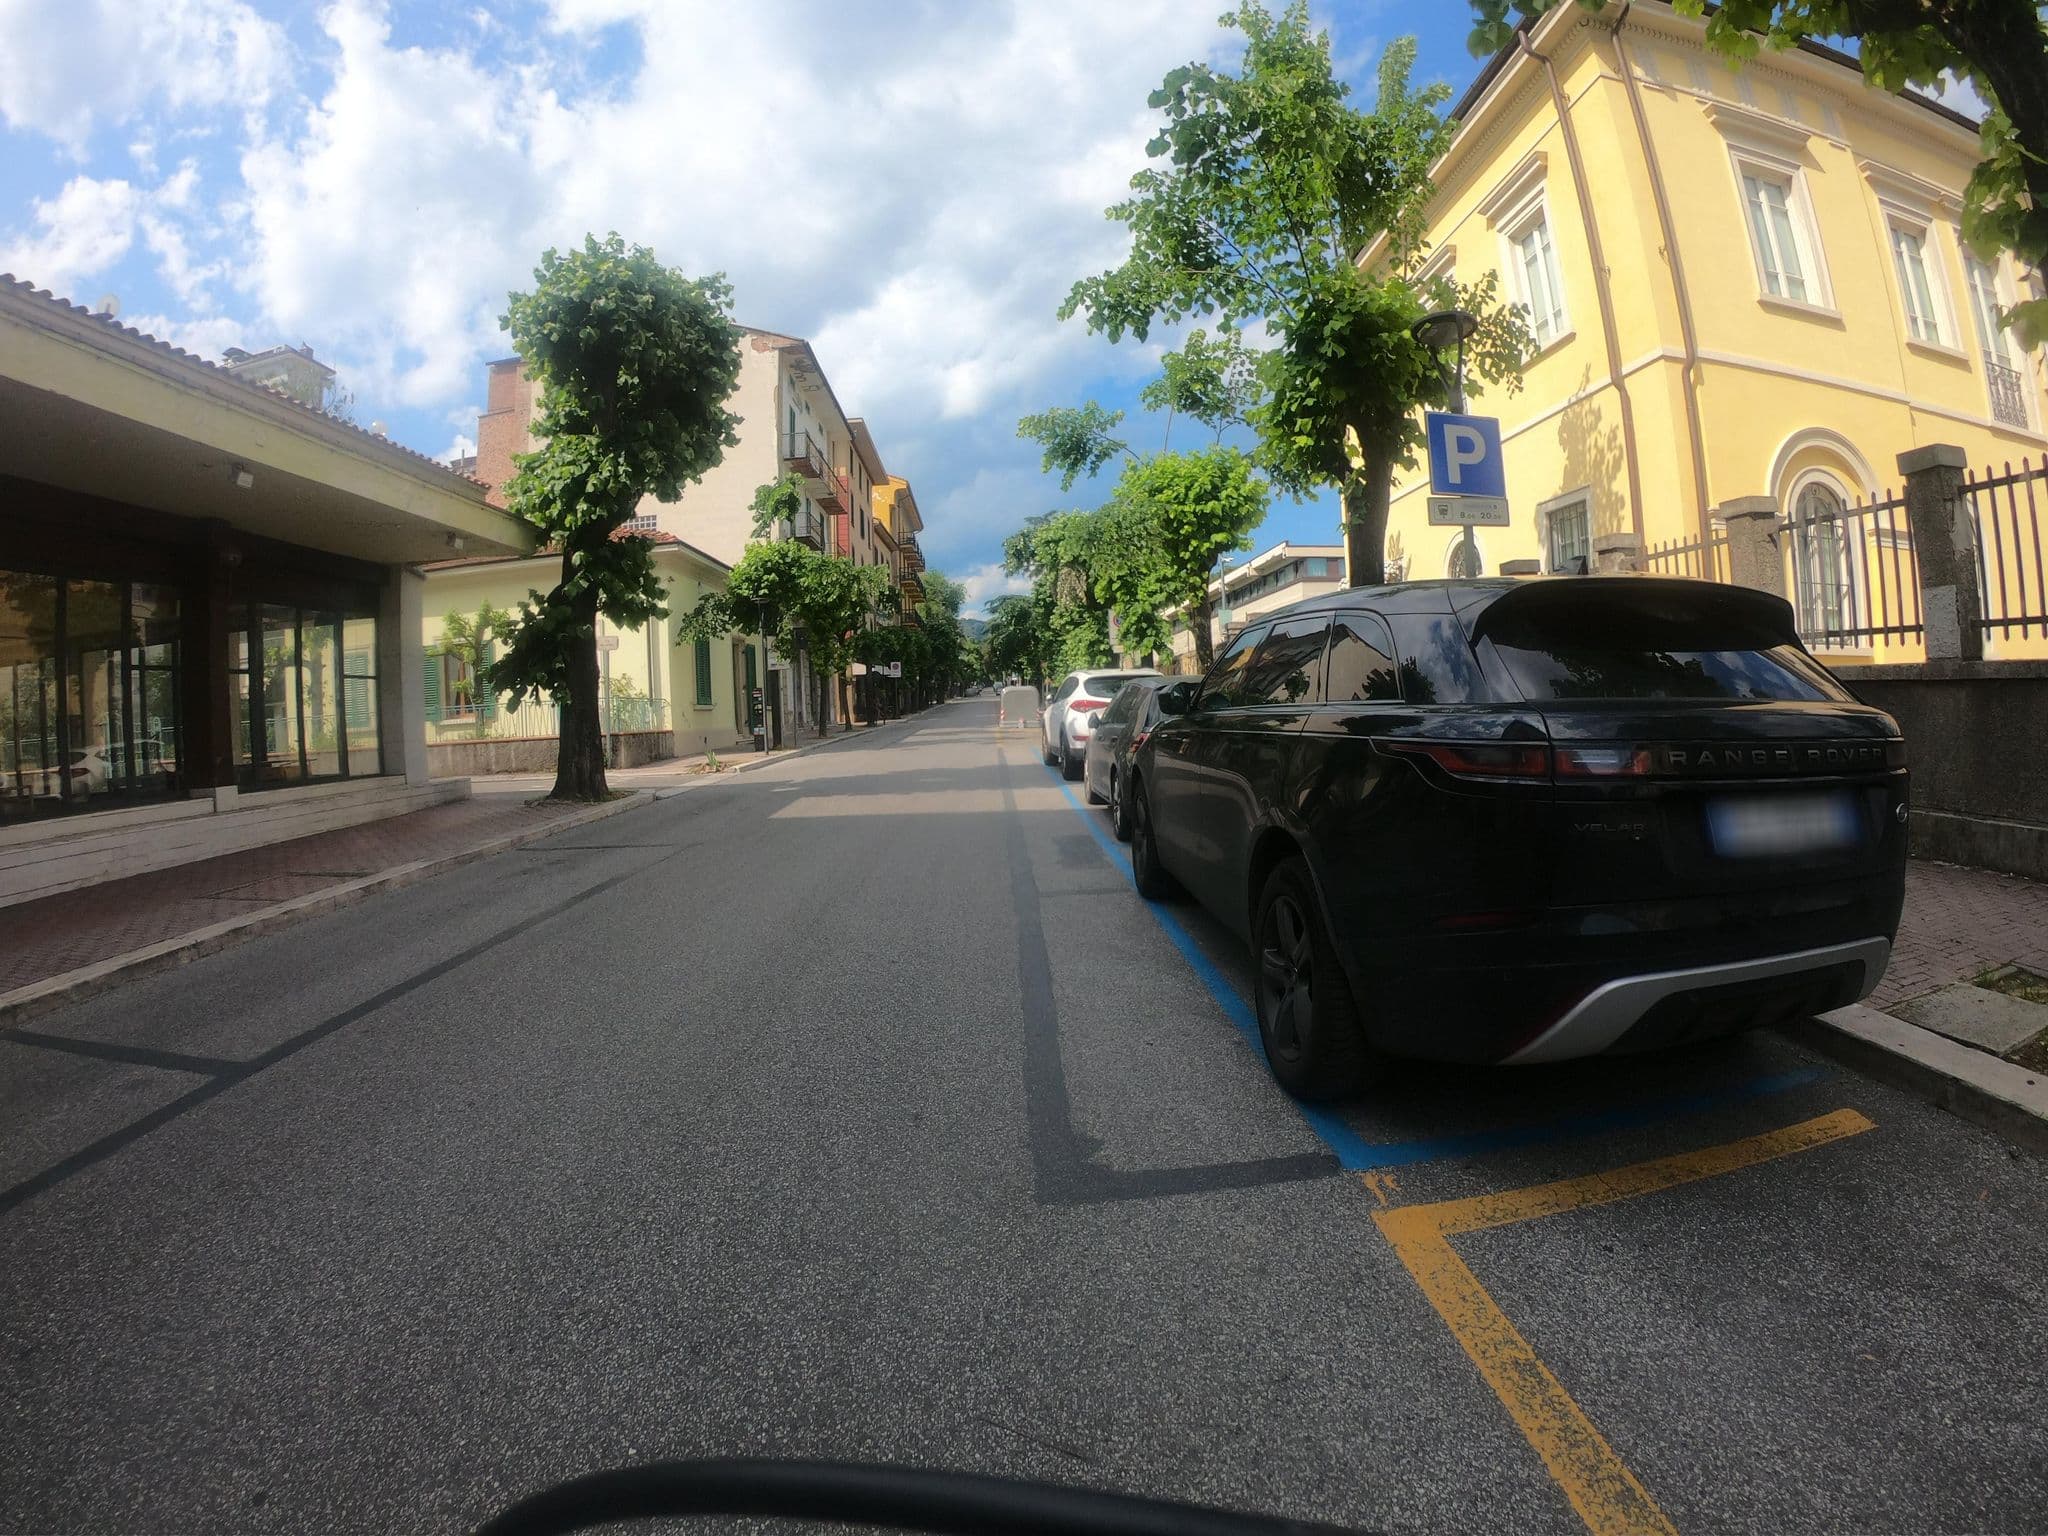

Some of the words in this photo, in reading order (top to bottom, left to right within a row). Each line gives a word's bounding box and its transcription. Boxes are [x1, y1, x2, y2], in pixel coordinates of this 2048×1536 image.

[1443, 423, 1486, 484] P
[1668, 749, 1789, 766] RANGE
[1806, 747, 1884, 763] ROVER
